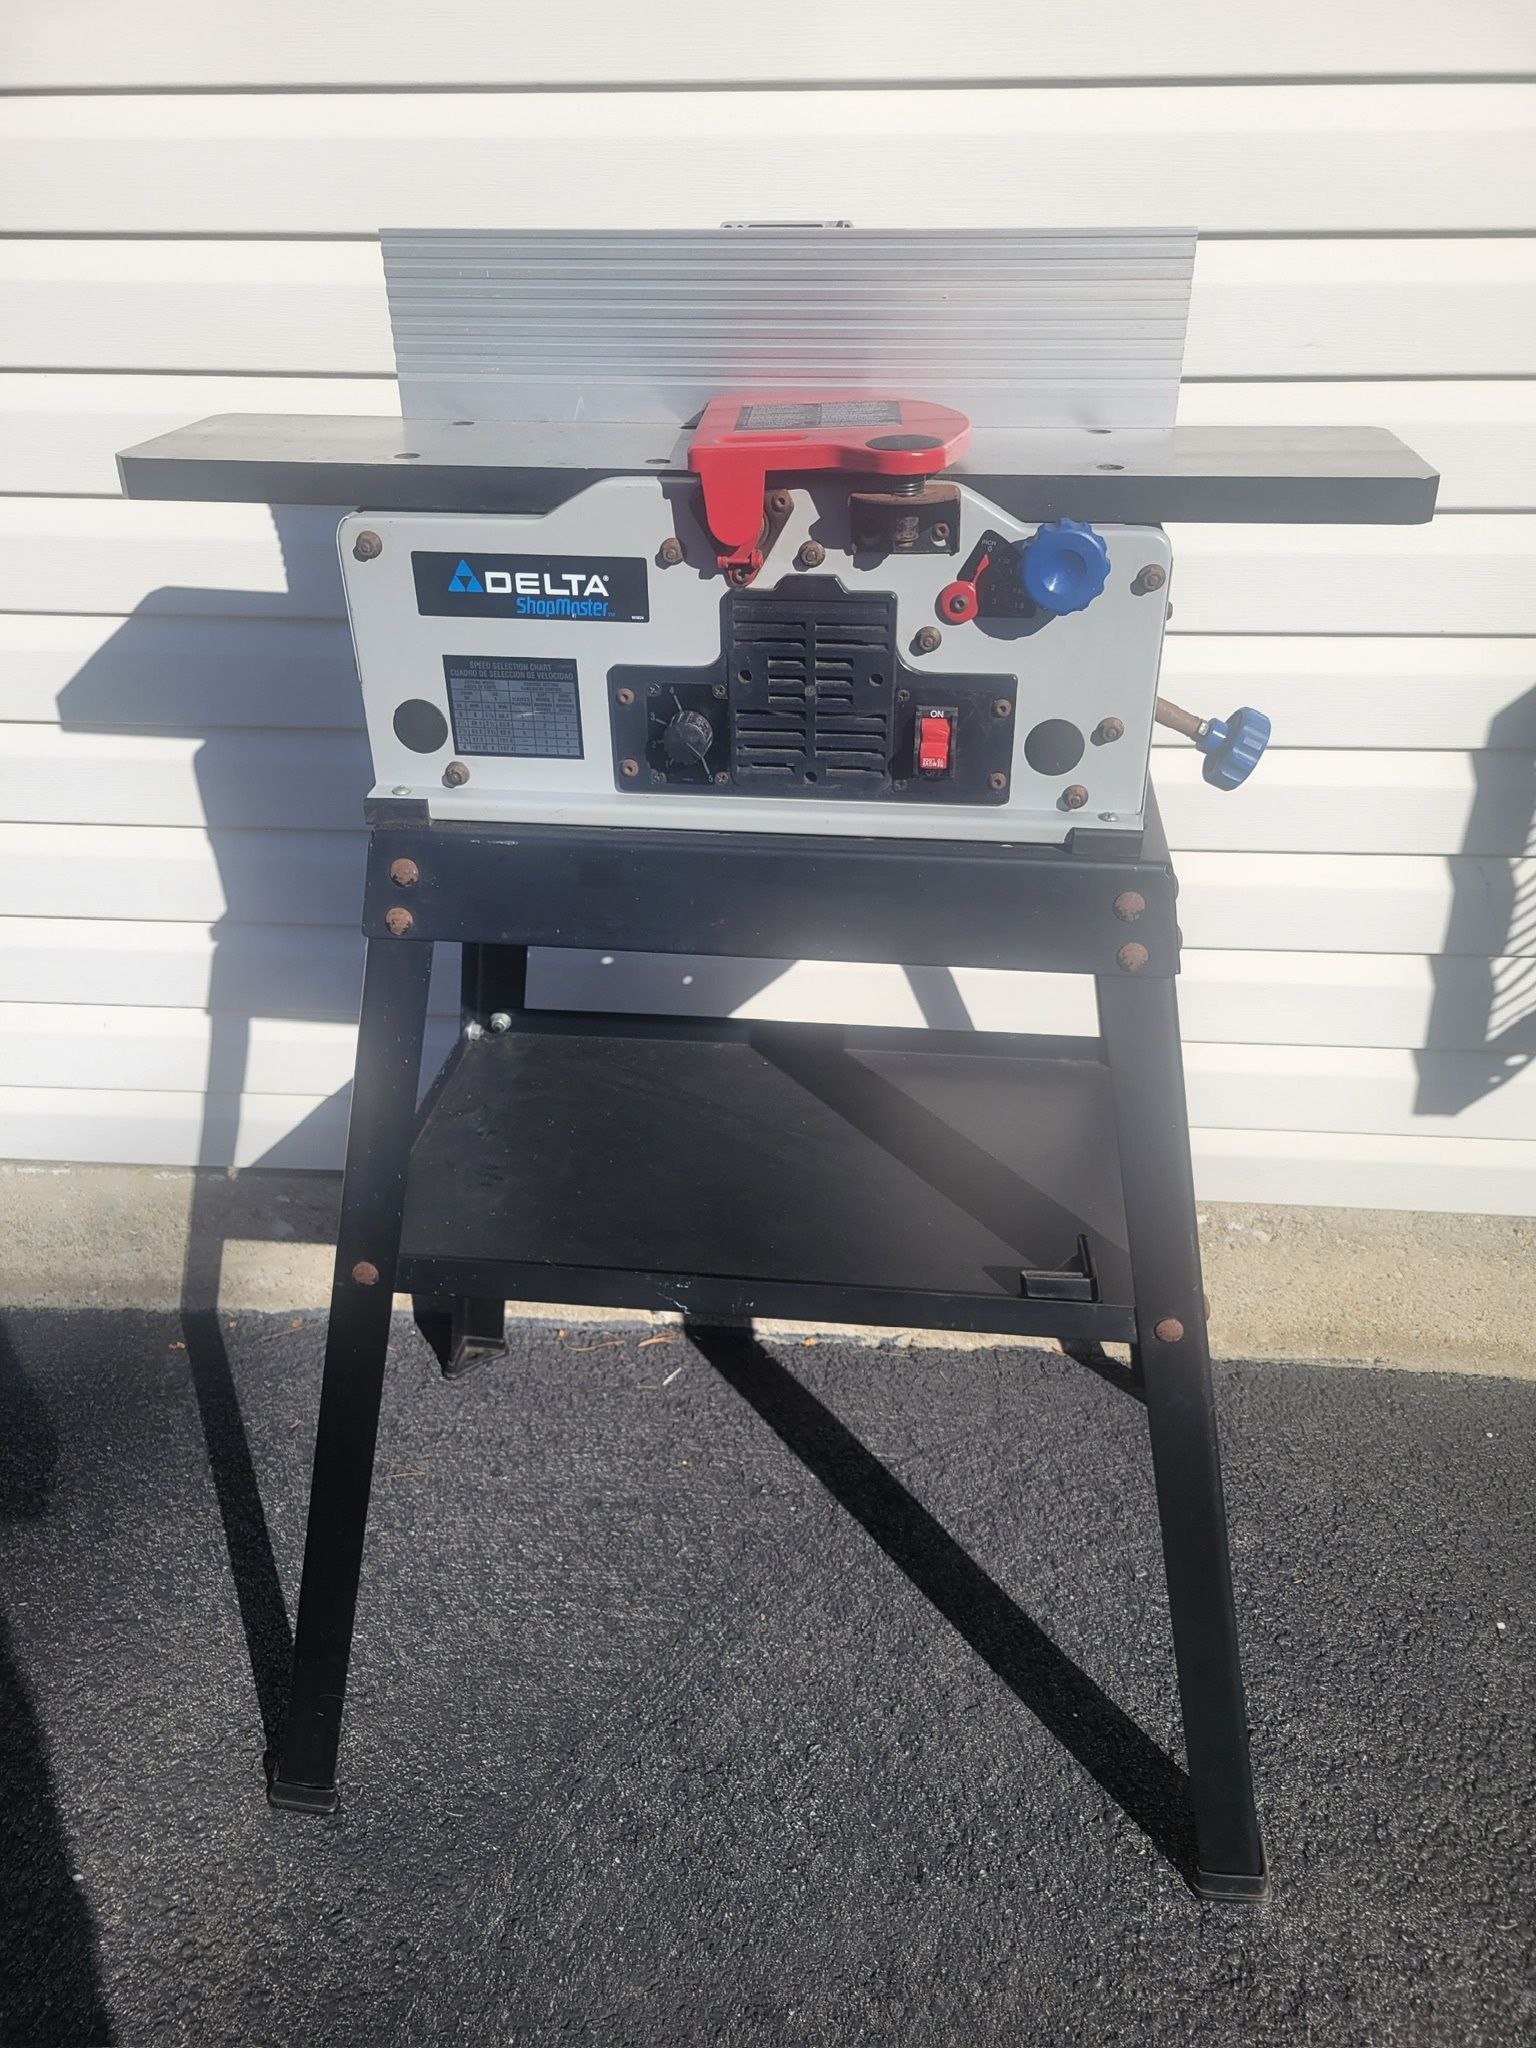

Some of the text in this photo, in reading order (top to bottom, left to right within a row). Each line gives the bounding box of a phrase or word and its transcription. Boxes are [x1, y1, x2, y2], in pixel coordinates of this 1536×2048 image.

[484, 571, 610, 597] DELTA
[515, 597, 609, 617] ShopMaster
[469, 661, 491, 670] SPEED
[493, 661, 528, 671] SELECTION
[529, 662, 552, 671] CHART
[450, 669, 478, 677] CUADRO
[479, 669, 488, 678] DE
[526, 671, 536, 679] DE
[536, 671, 574, 680] VELOCIDAD
[669, 686, 675, 694] 4
[649, 712, 656, 721] 3
[930, 710, 944, 718] ON
[708, 774, 714, 783] 5
